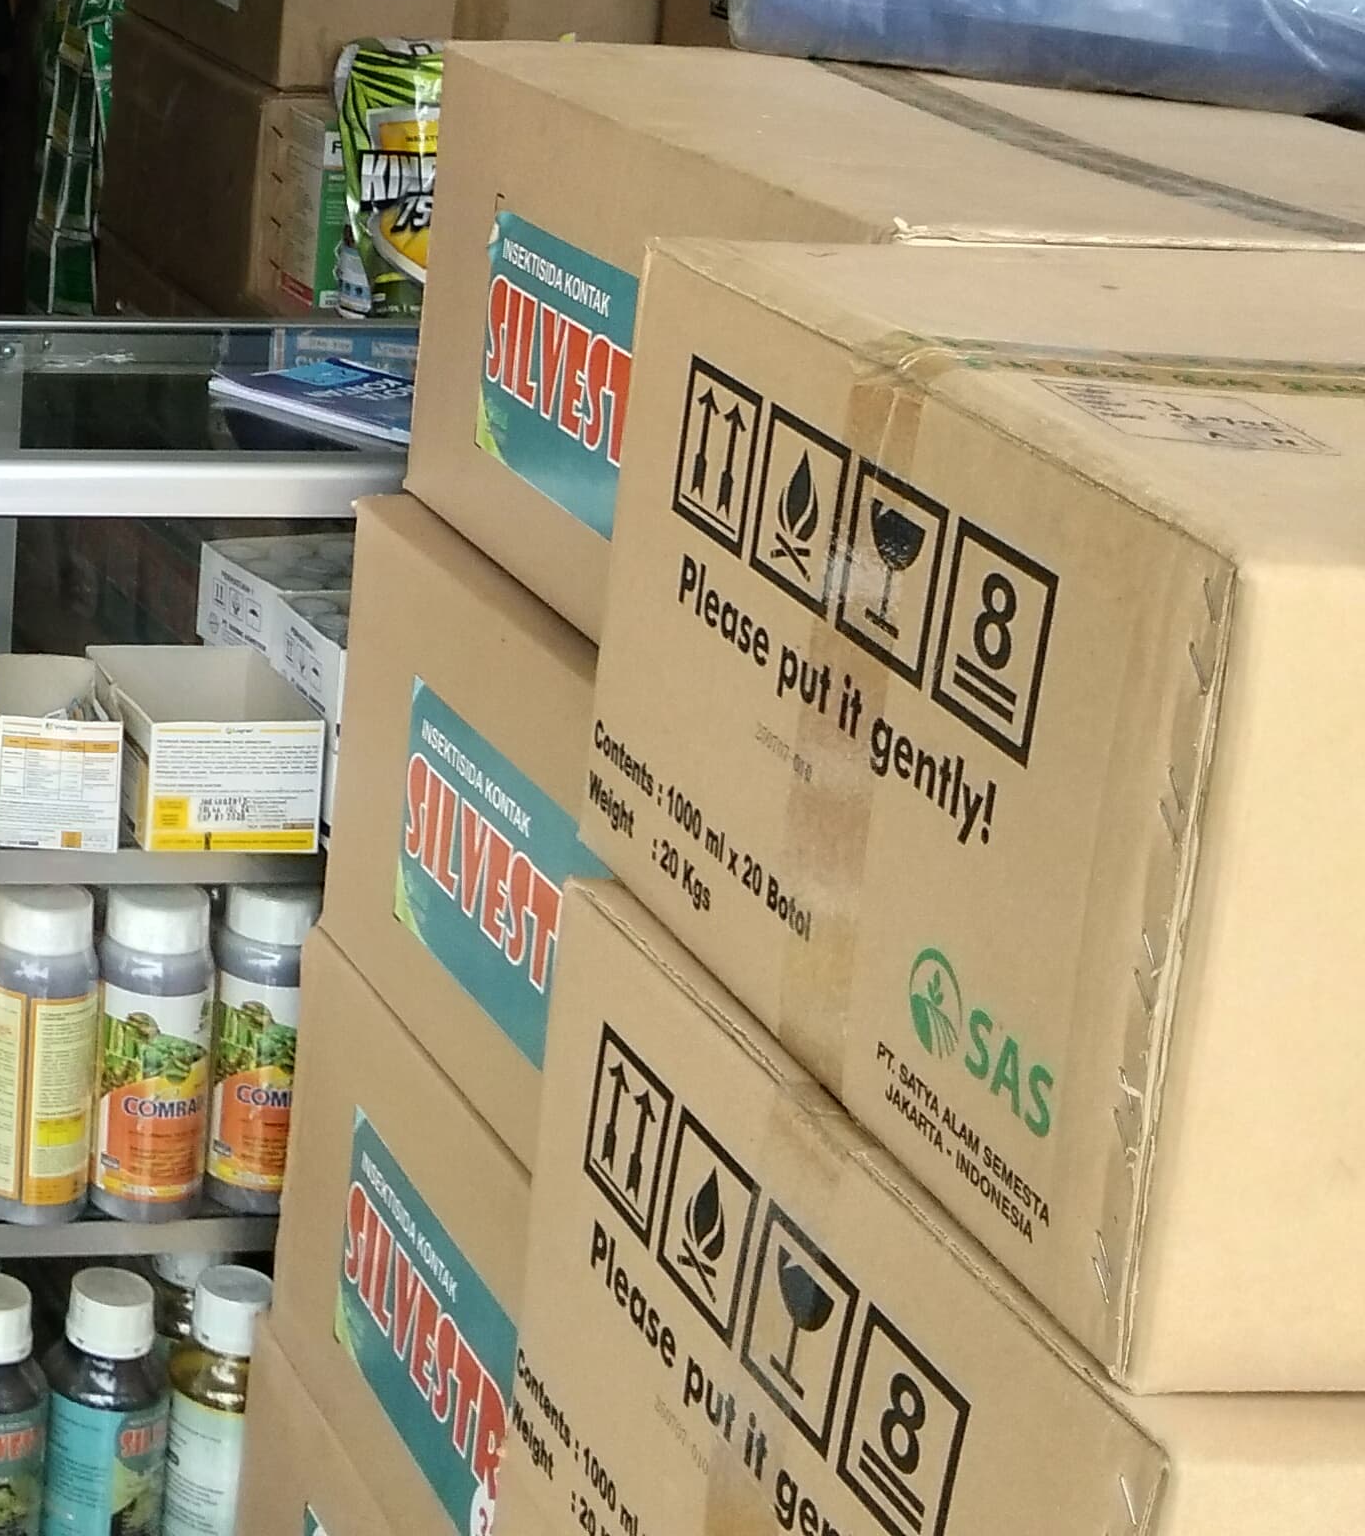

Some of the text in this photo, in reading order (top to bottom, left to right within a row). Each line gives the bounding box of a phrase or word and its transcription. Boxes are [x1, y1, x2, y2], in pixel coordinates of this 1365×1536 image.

[502, 237, 611, 319] INSEKTISIDA KONTAK
[972, 572, 1017, 671] 8
[678, 553, 998, 846] Please put it gently!
[421, 717, 532, 838] INSEKTISIDA KONTAK
[588, 770, 712, 913] Weight 20 Kgs
[593, 718, 812, 942] Contents 1000 ml 20 Botol
[404, 751, 566, 995] SILVEST
[898, 1063, 940, 1115] SATYA
[943, 1104, 980, 1155] ALAM
[981, 1147, 1051, 1228] SEMESTA
[963, 1006, 1055, 1140] SAS
[884, 1083, 1034, 1244] JAKARTA INDONESIA
[416, 1230, 459, 1303] KONTAK
[590, 1219, 769, 1482] Please put it
[879, 1371, 925, 1475] 8
[516, 1347, 618, 1510] Contents 1000
